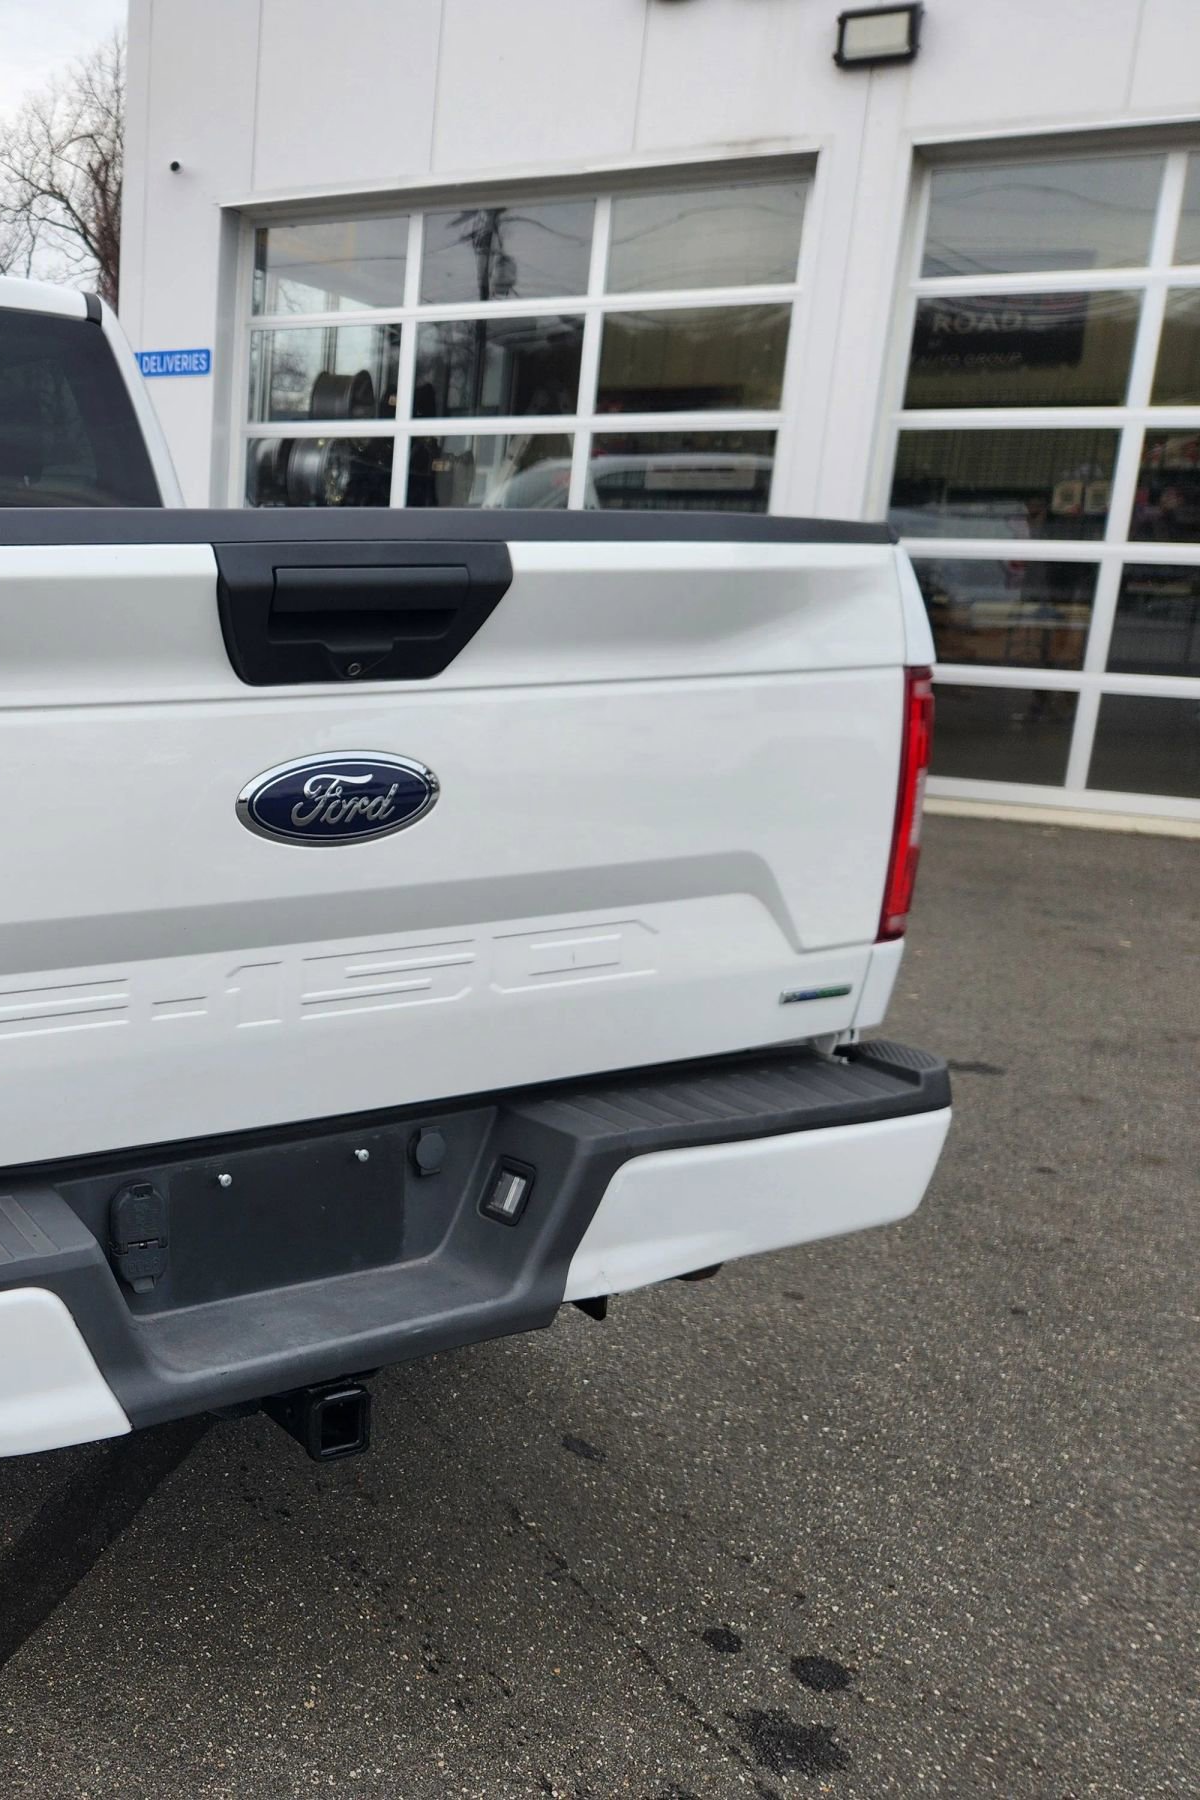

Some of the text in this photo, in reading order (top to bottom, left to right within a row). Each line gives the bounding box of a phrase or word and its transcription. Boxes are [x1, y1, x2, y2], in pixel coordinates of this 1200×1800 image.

[931, 311, 1025, 334] ROAD
[141, 353, 208, 374] DELIVERIES
[290, 773, 399, 827] Ford
